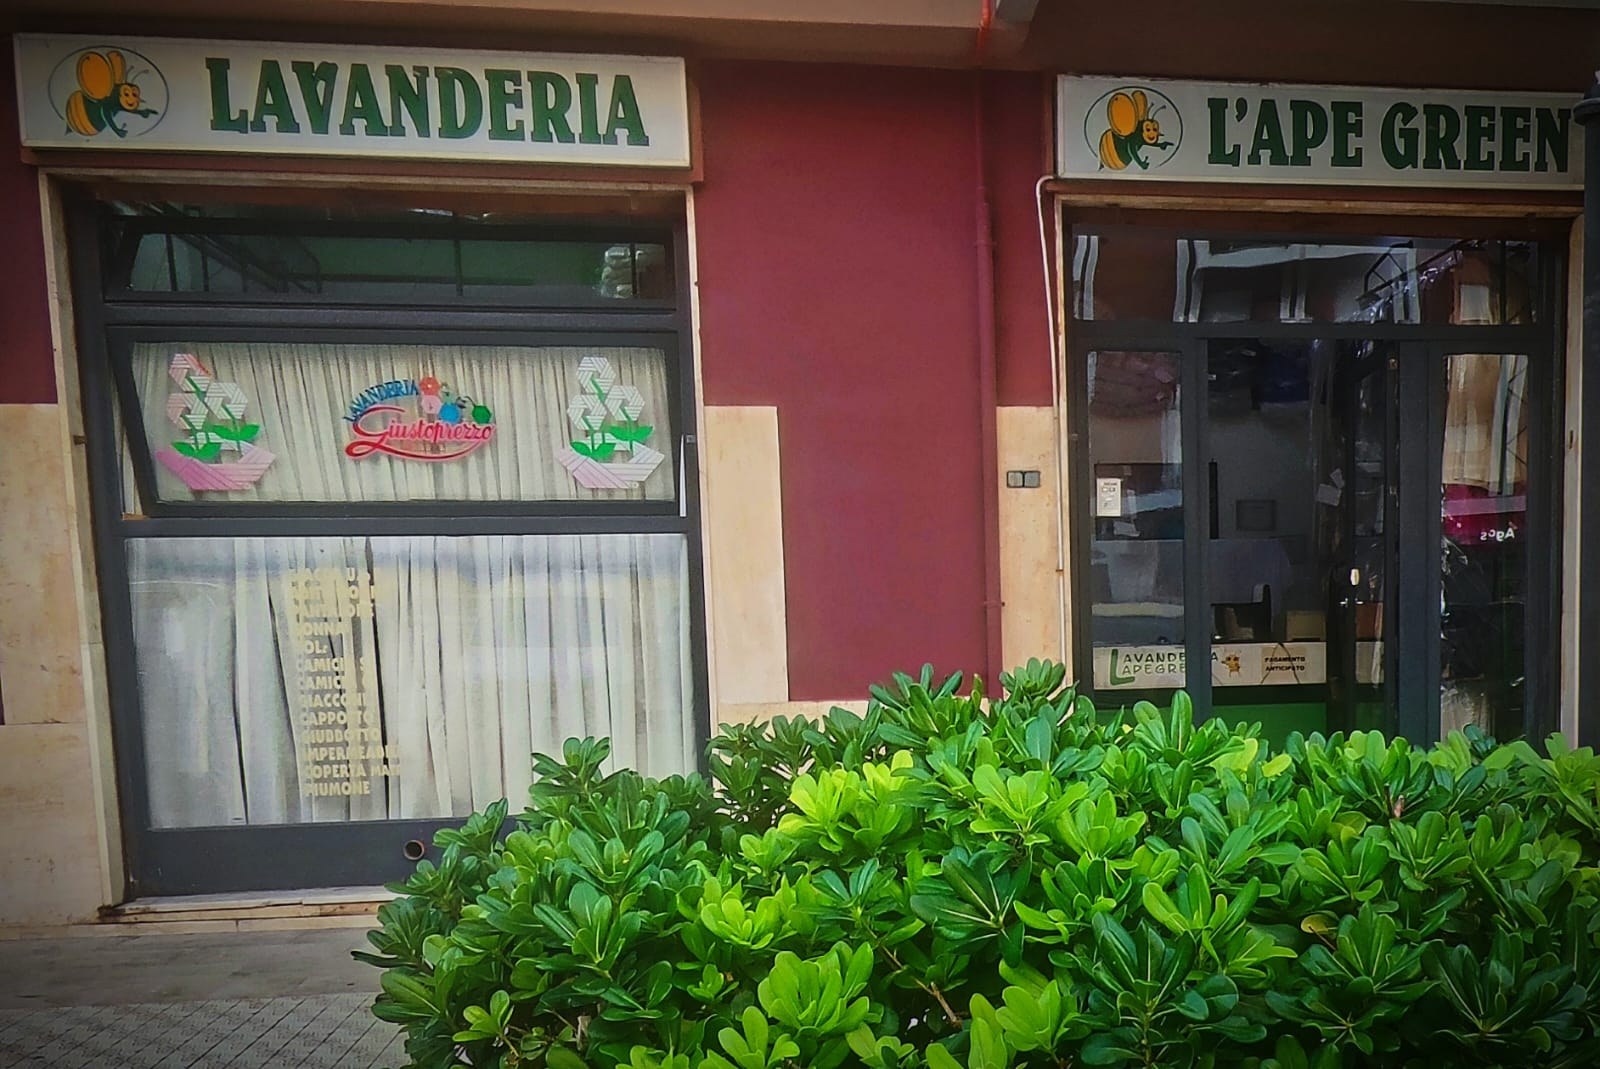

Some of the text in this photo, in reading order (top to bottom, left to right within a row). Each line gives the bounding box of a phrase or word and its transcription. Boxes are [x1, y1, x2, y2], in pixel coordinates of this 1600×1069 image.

[205, 57, 650, 147] LAVANDERIA
[1207, 97, 1572, 173] L'APE GREEN
[343, 379, 420, 422] LAVANDERIA
